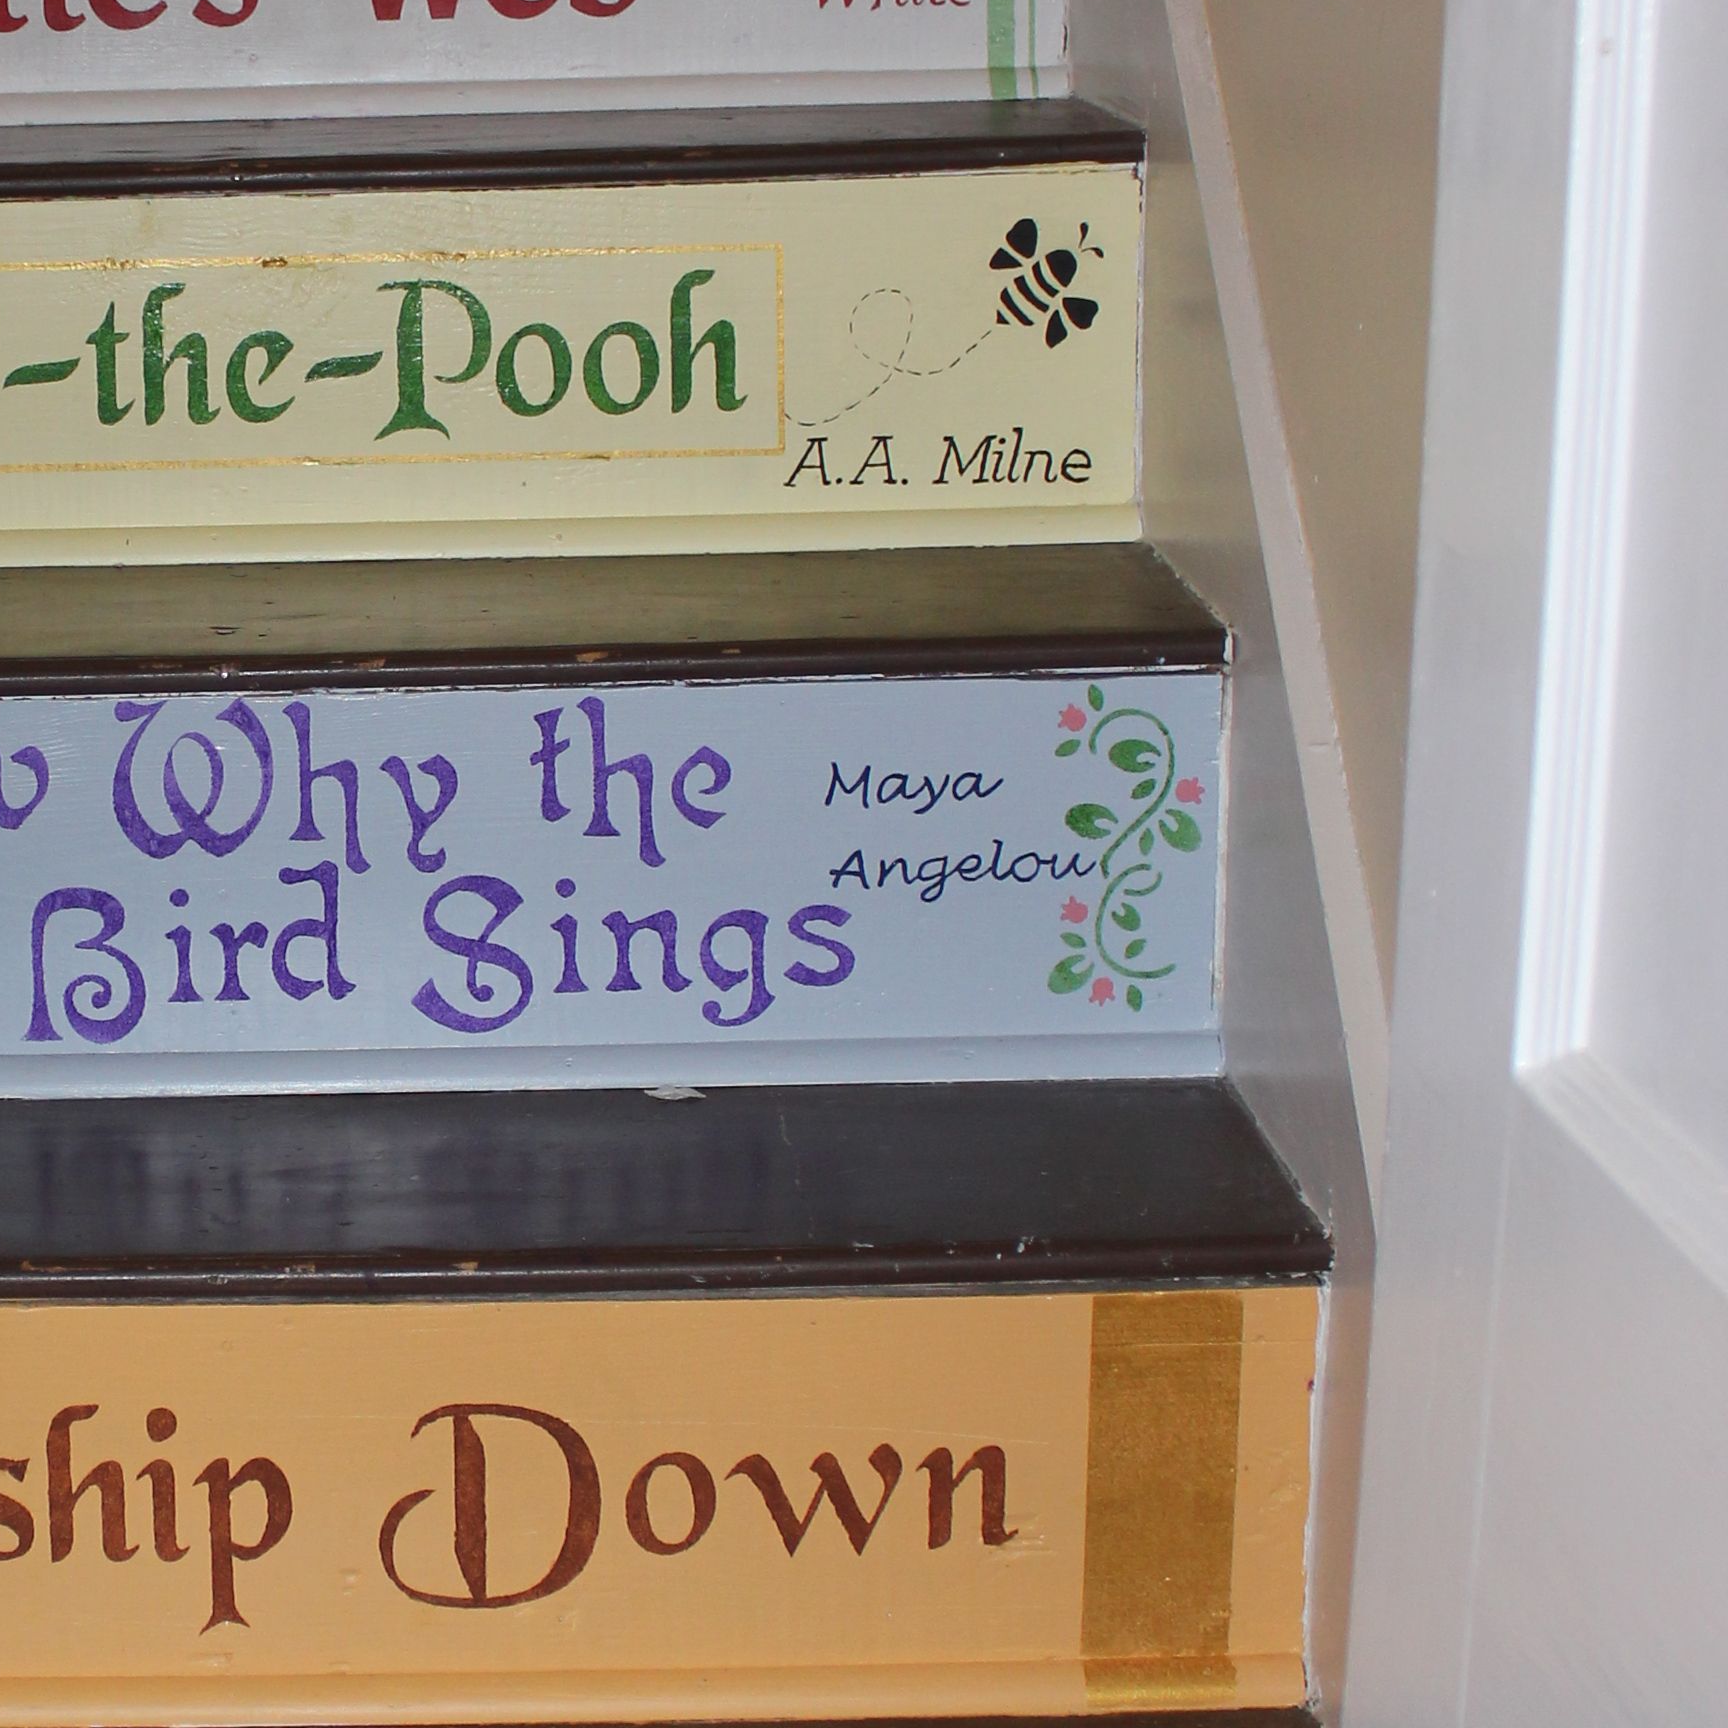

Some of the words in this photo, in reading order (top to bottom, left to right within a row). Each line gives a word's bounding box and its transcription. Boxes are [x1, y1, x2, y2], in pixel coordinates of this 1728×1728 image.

[784, 433, 912, 489] A.A.
[930, 428, 1093, 487] Milne
[108, 699, 459, 875] Why
[531, 696, 735, 867] the
[823, 760, 1004, 817] Maya
[828, 837, 1098, 903] Angelou
[23, 860, 358, 1045] Bird
[410, 873, 858, 1032] Sings
[379, 1401, 1019, 1610] Down
